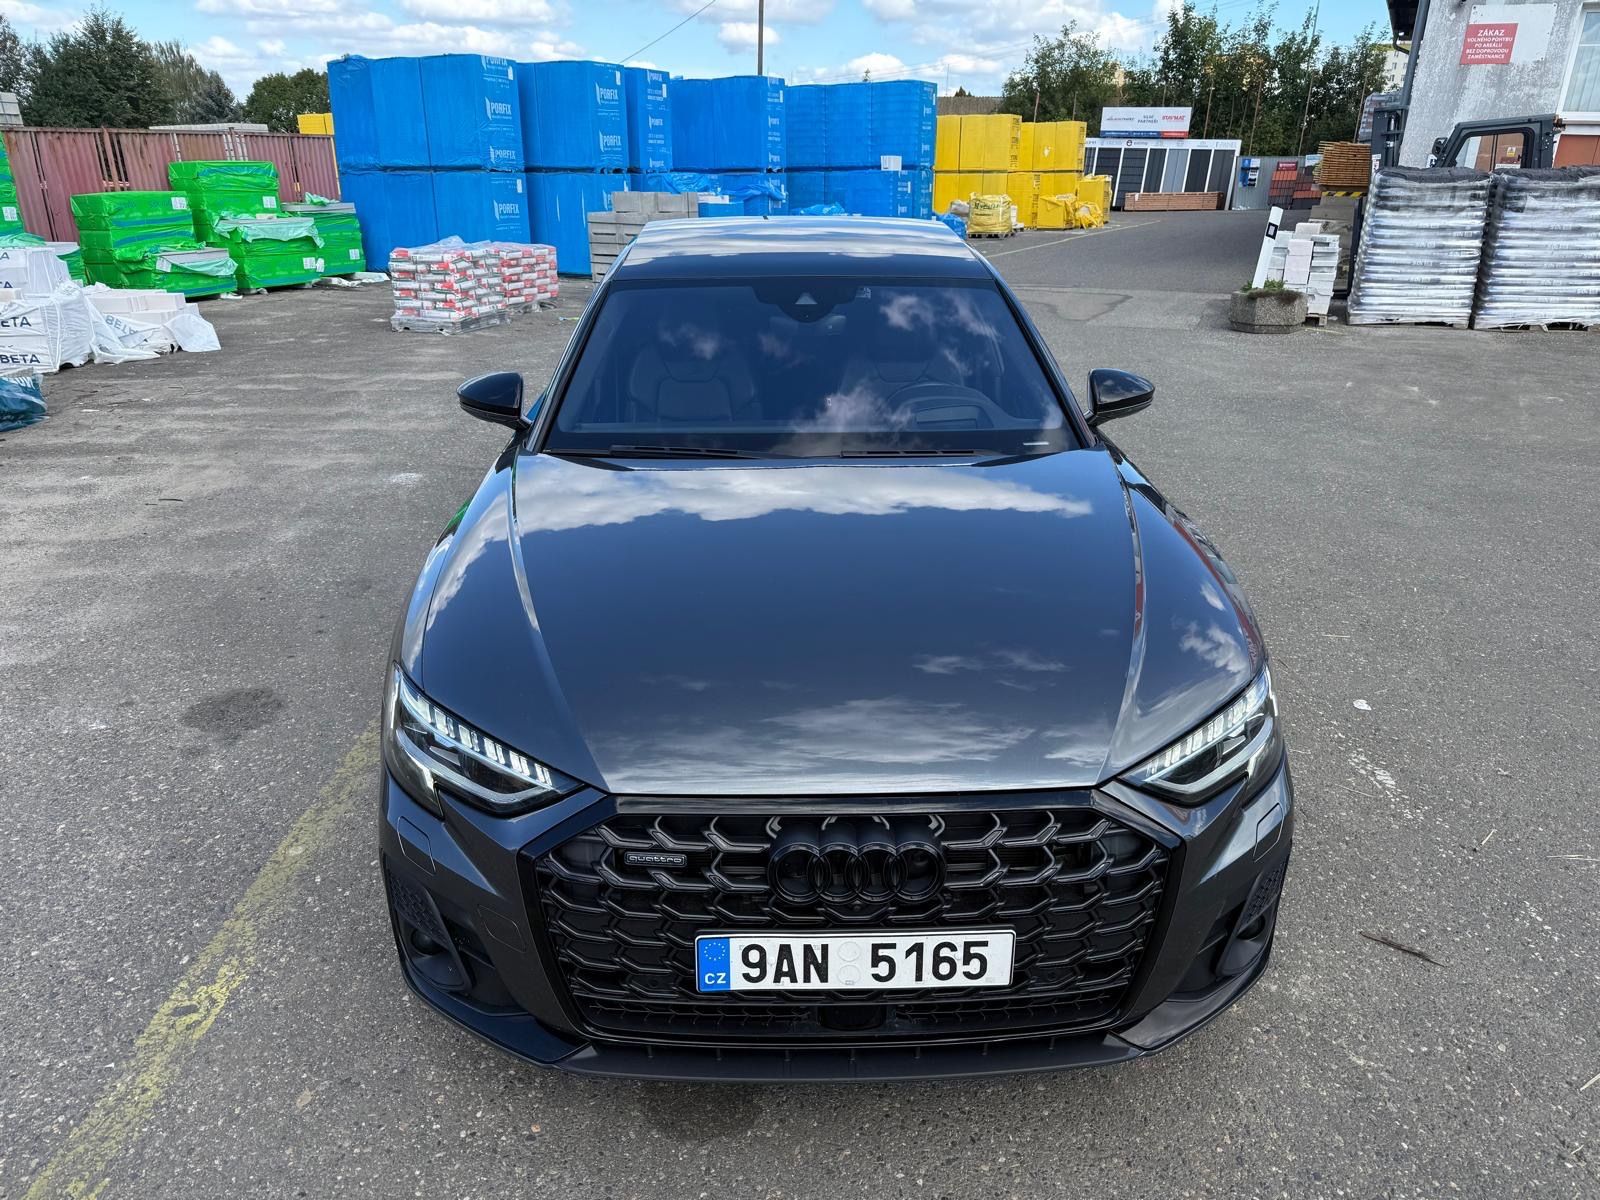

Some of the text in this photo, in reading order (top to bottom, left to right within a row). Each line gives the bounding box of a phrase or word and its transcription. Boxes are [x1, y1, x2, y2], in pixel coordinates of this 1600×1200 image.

[1477, 29, 1505, 37] ZÁKAZ
[491, 102, 512, 115] PORFIX
[603, 135, 622, 146] PORFIX
[494, 149, 516, 160] PORFIX
[498, 203, 520, 214] PORFIX
[0, 354, 41, 364] BETA
[629, 855, 682, 863] quattro
[740, 940, 989, 984] 9AN 5165
[704, 973, 726, 985] CZ
